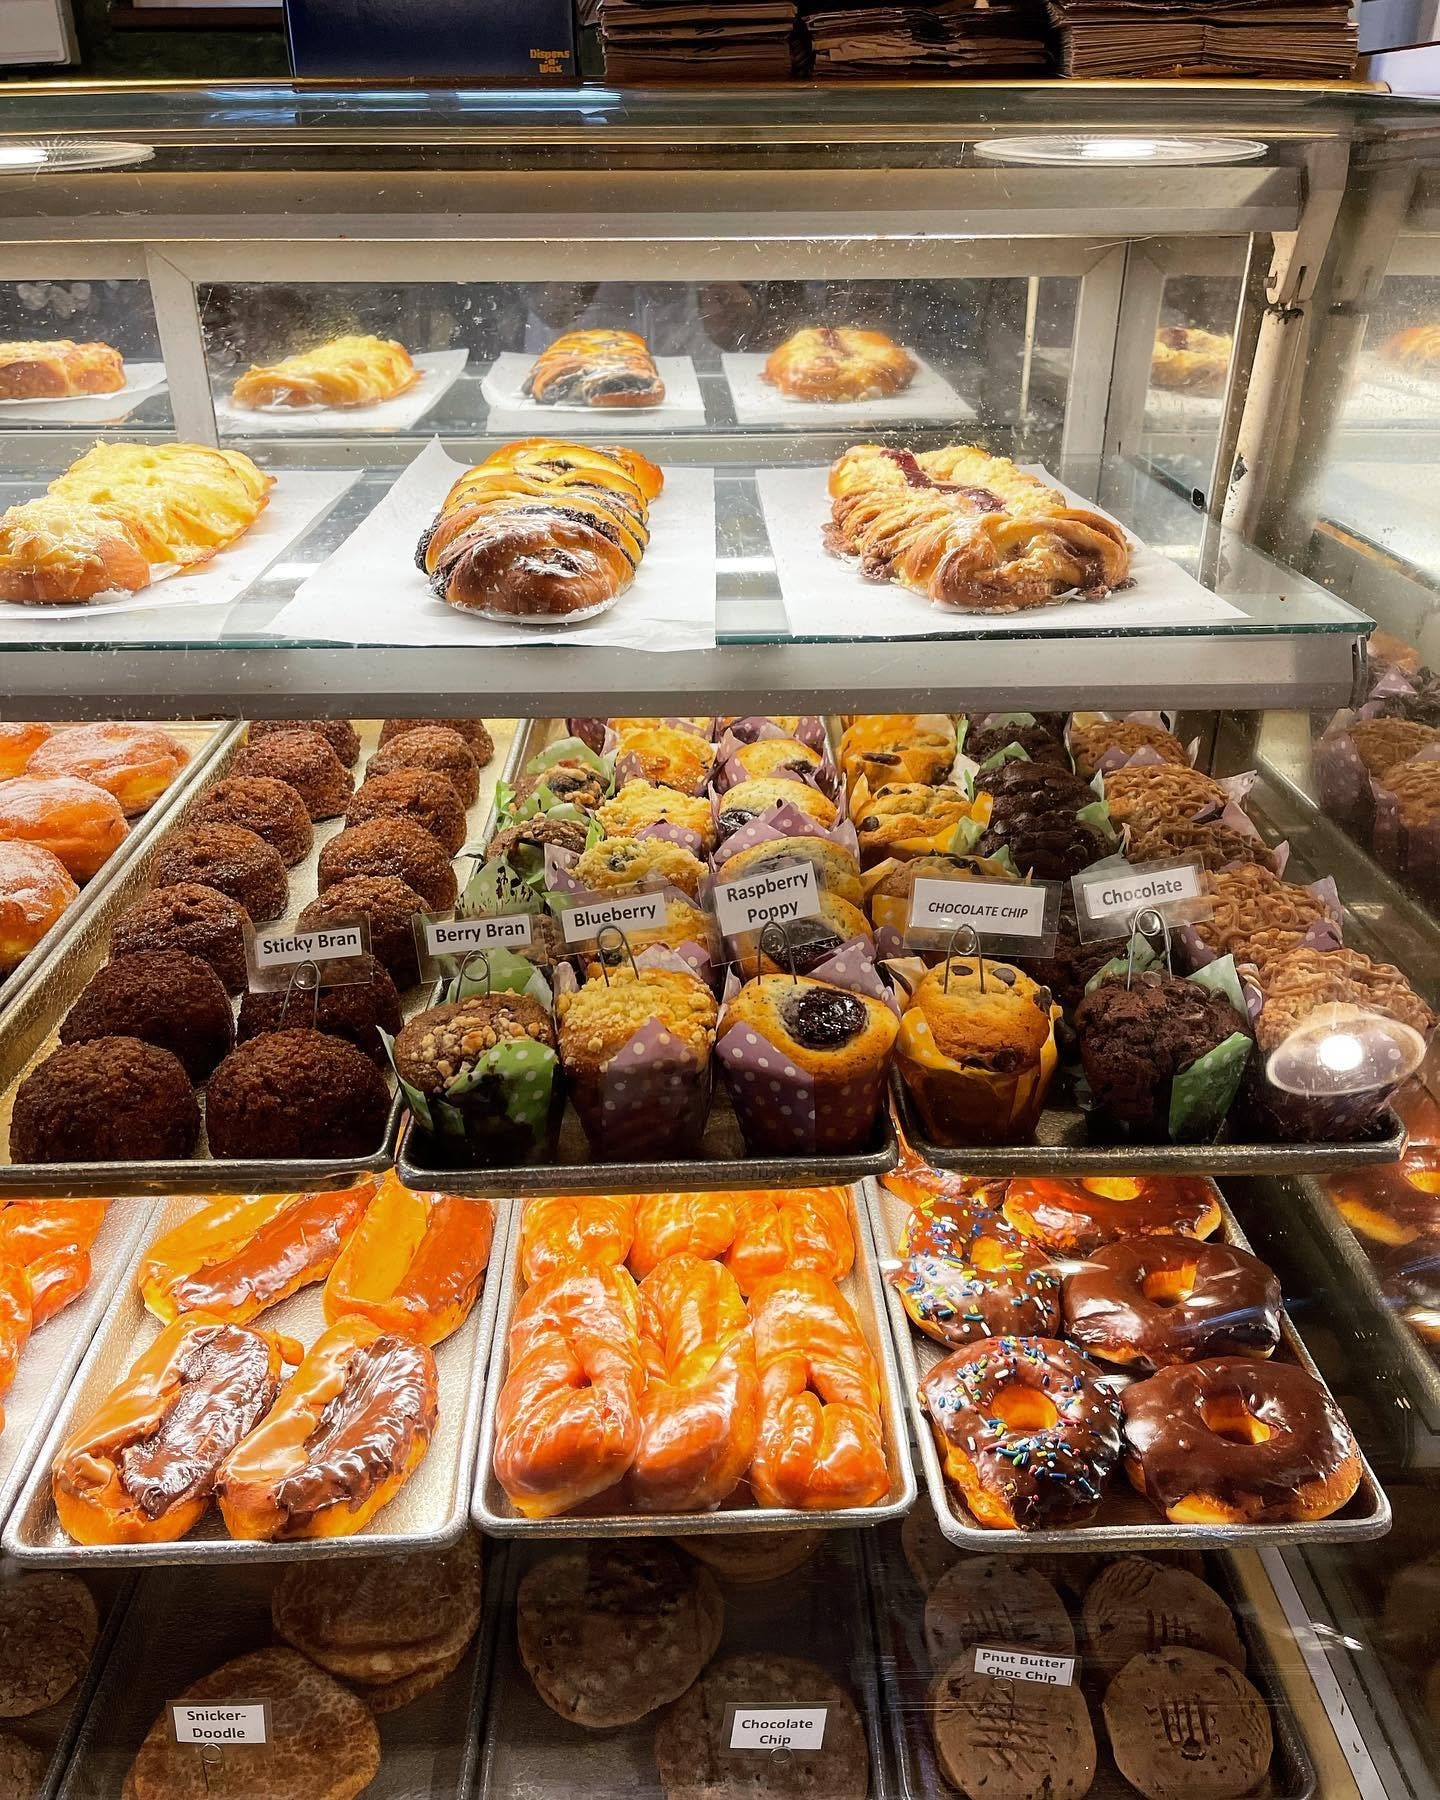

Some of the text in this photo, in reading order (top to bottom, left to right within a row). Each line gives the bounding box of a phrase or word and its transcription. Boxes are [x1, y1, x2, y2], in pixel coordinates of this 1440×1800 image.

[726, 872, 809, 902] Raspberry
[1102, 880, 1183, 906] Chocolate
[573, 904, 656, 928] Blueberry
[747, 901, 799, 923] Poppy
[928, 902, 1029, 918] CHOCOLATE CHIP
[435, 923, 525, 943] Berry Bran
[263, 933, 357, 955] Sticky Bran
[982, 1652, 1066, 1669] Pnut Butter
[986, 1666, 1057, 1686] Choc Chip
[186, 1710, 247, 1721] Snicker-
[741, 1719, 814, 1729] Chocolate
[192, 1727, 246, 1739] Doodle
[759, 1734, 792, 1747] Chip
